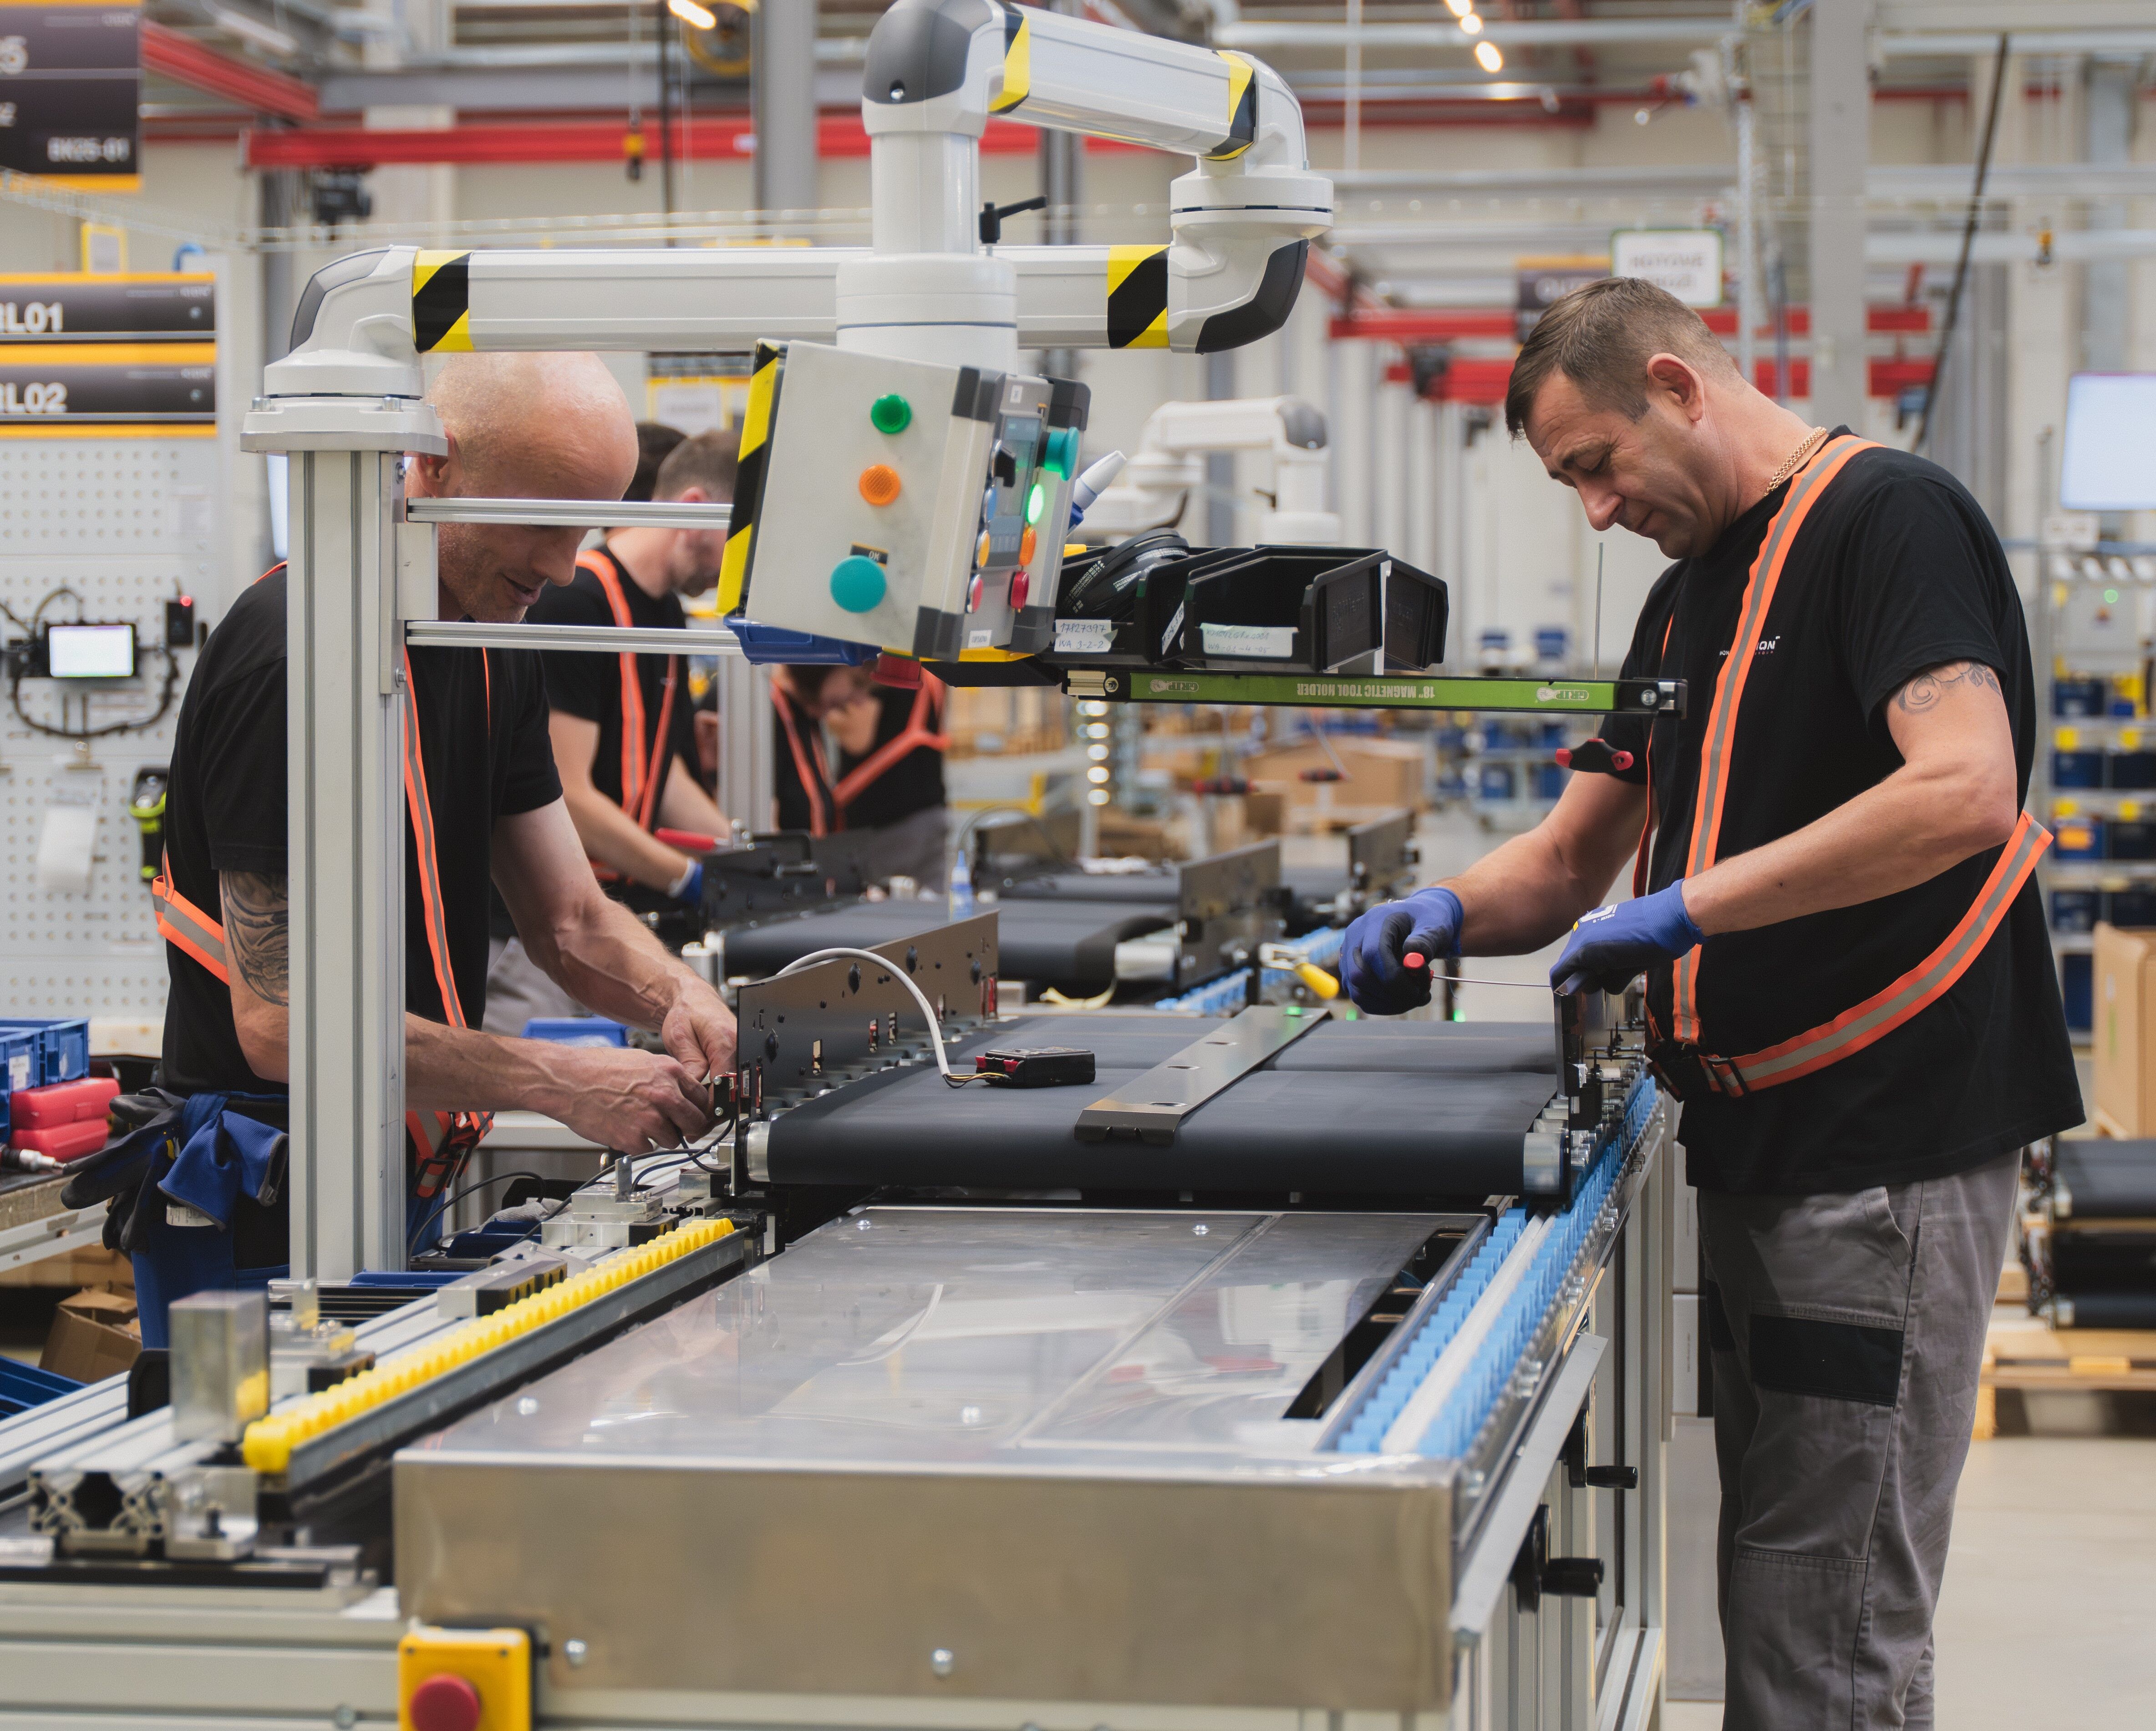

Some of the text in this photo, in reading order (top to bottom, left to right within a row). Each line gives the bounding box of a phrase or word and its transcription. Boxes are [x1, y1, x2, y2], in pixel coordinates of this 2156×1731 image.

[0, 35, 28, 75] 5
[0, 302, 63, 333] L01
[0, 382, 67, 413] L02
[1297, 683, 1435, 698] 18" MAGNETIC TOOL HOLDER
